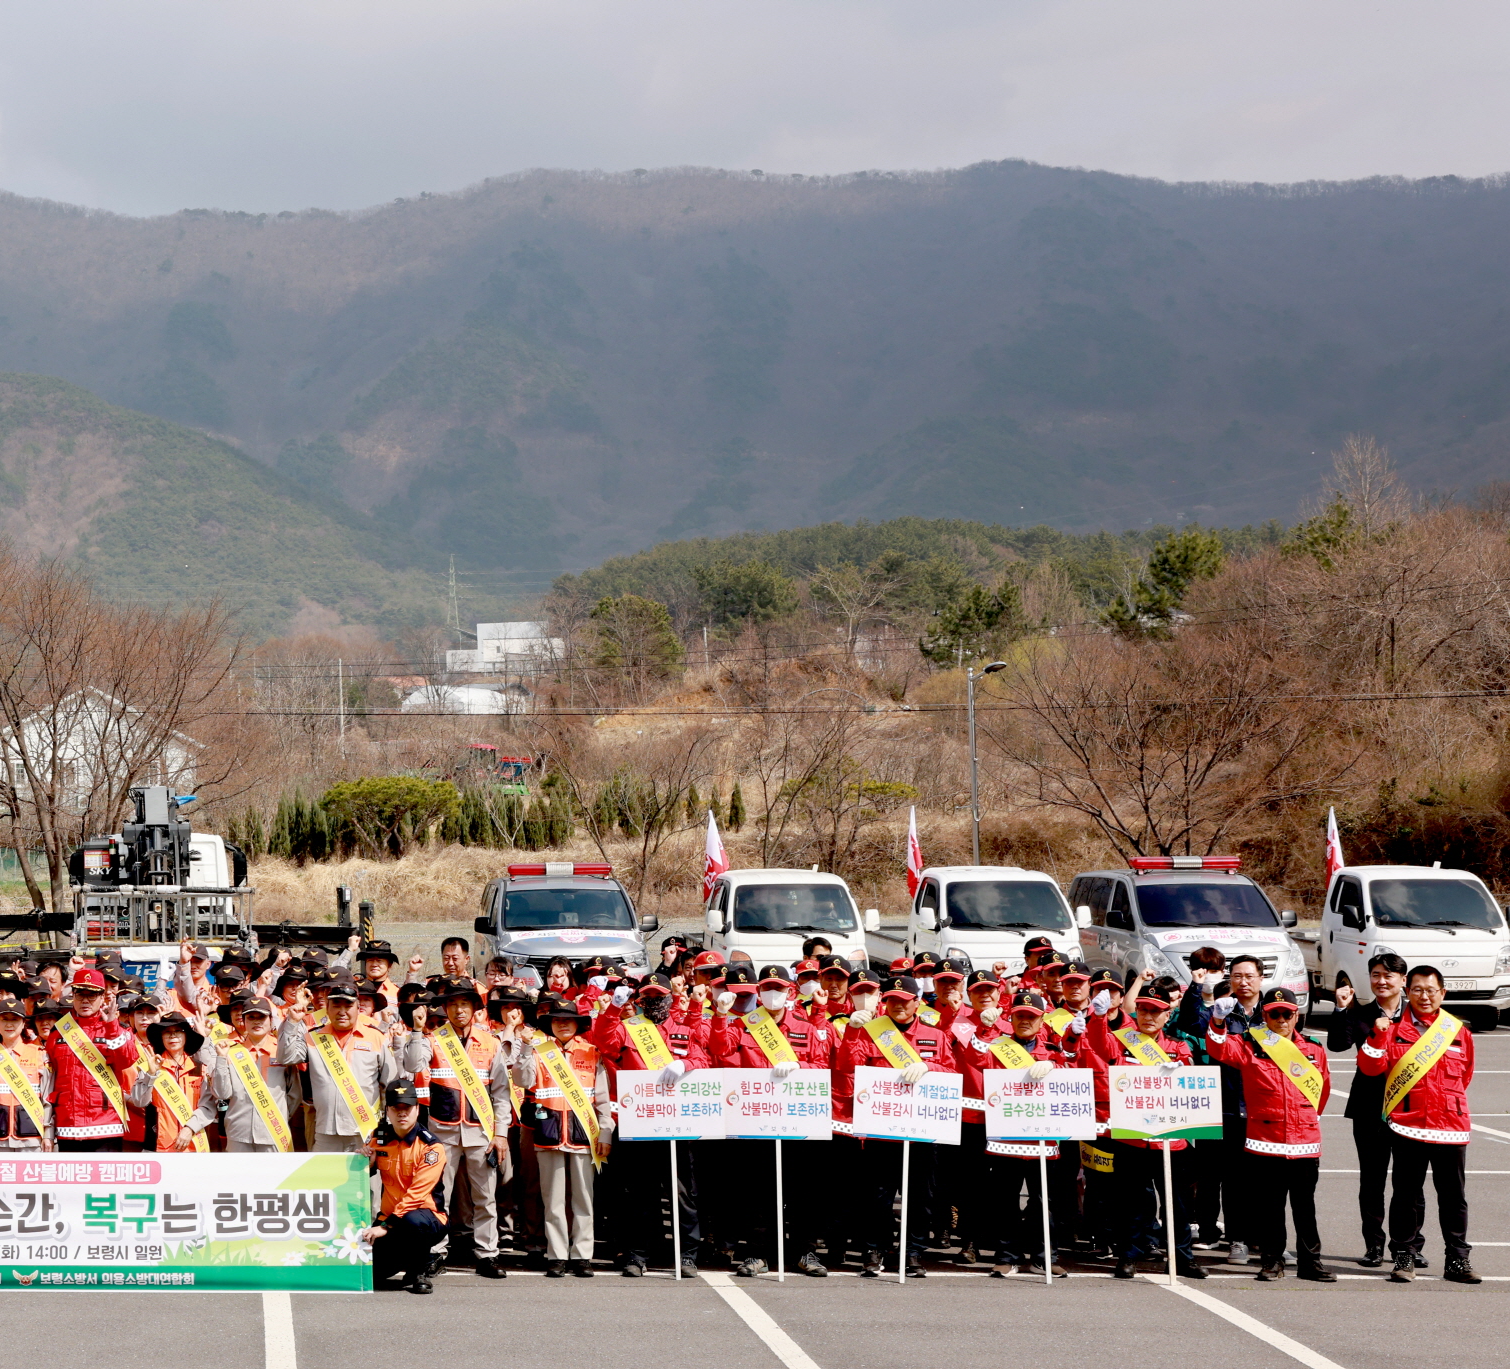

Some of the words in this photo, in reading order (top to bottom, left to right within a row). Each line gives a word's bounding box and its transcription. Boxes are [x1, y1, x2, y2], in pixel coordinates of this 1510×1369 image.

[89, 867, 112, 876] SKY
[636, 1027, 658, 1054] 건전한
[756, 1024, 779, 1050] 건전한
[998, 1044, 1023, 1066] 건전한
[1414, 1032, 1446, 1066] 품격있는
[70, 1032, 96, 1062] 산불조심
[94, 1063, 114, 1089] 예방이
[4, 1064, 24, 1088] 불씨는
[21, 1088, 35, 1106] 잠깐
[318, 1034, 336, 1058] 불씨는
[332, 1060, 344, 1076] 잠깐
[342, 1077, 360, 1104] 산불은
[356, 1105, 370, 1122] 평생
[446, 1040, 464, 1066] 불씨는
[460, 1068, 474, 1086] 잠깐
[472, 1088, 488, 1114] 산불은
[1133, 1076, 1172, 1090] 산불방지
[1177, 1076, 1216, 1090] 계절없고
[160, 1079, 180, 1104] 불씨는
[554, 1063, 574, 1088] 불씨는
[570, 1089, 584, 1108] 잠깐
[582, 1109, 596, 1134] 산불은
[634, 1083, 676, 1097] 아름다운
[680, 1082, 722, 1096] 우리강산
[741, 1081, 774, 1096] 힘모아
[782, 1081, 828, 1096] 가꾼산림
[872, 1080, 914, 1098] 산불방지
[918, 1084, 959, 1100] 계절없고
[1002, 1082, 1044, 1096] 산불발생
[1049, 1082, 1090, 1096] 막아내어
[242, 1064, 259, 1089] 불씨는
[256, 1090, 270, 1108] 잠깐
[267, 1110, 284, 1134] 산불은
[741, 1102, 782, 1116] 산불막아
[787, 1102, 829, 1116] 보존하자
[1124, 1096, 1164, 1110] 산불감시
[1170, 1096, 1210, 1110] 너나없다
[635, 1103, 676, 1118] 산불막아
[681, 1102, 722, 1116] 보존하자
[871, 1101, 913, 1118] 산불감시
[918, 1105, 958, 1122] 너나없다
[1002, 1102, 1046, 1117] 금수강산
[1050, 1103, 1092, 1117] 보존하자
[23, 1163, 92, 1182] 산불예방
[99, 1163, 150, 1182] 캠페인
[83, 1193, 197, 1234] 복구는
[212, 1193, 330, 1234] 한평생
[26, 1245, 67, 1260] 14:00
[74, 1246, 80, 1260] /
[87, 1245, 128, 1260] 보령시
[135, 1245, 162, 1260] 일원
[40, 1272, 98, 1285] 보령소방서
[102, 1272, 194, 1285] 의용소방대연합회
